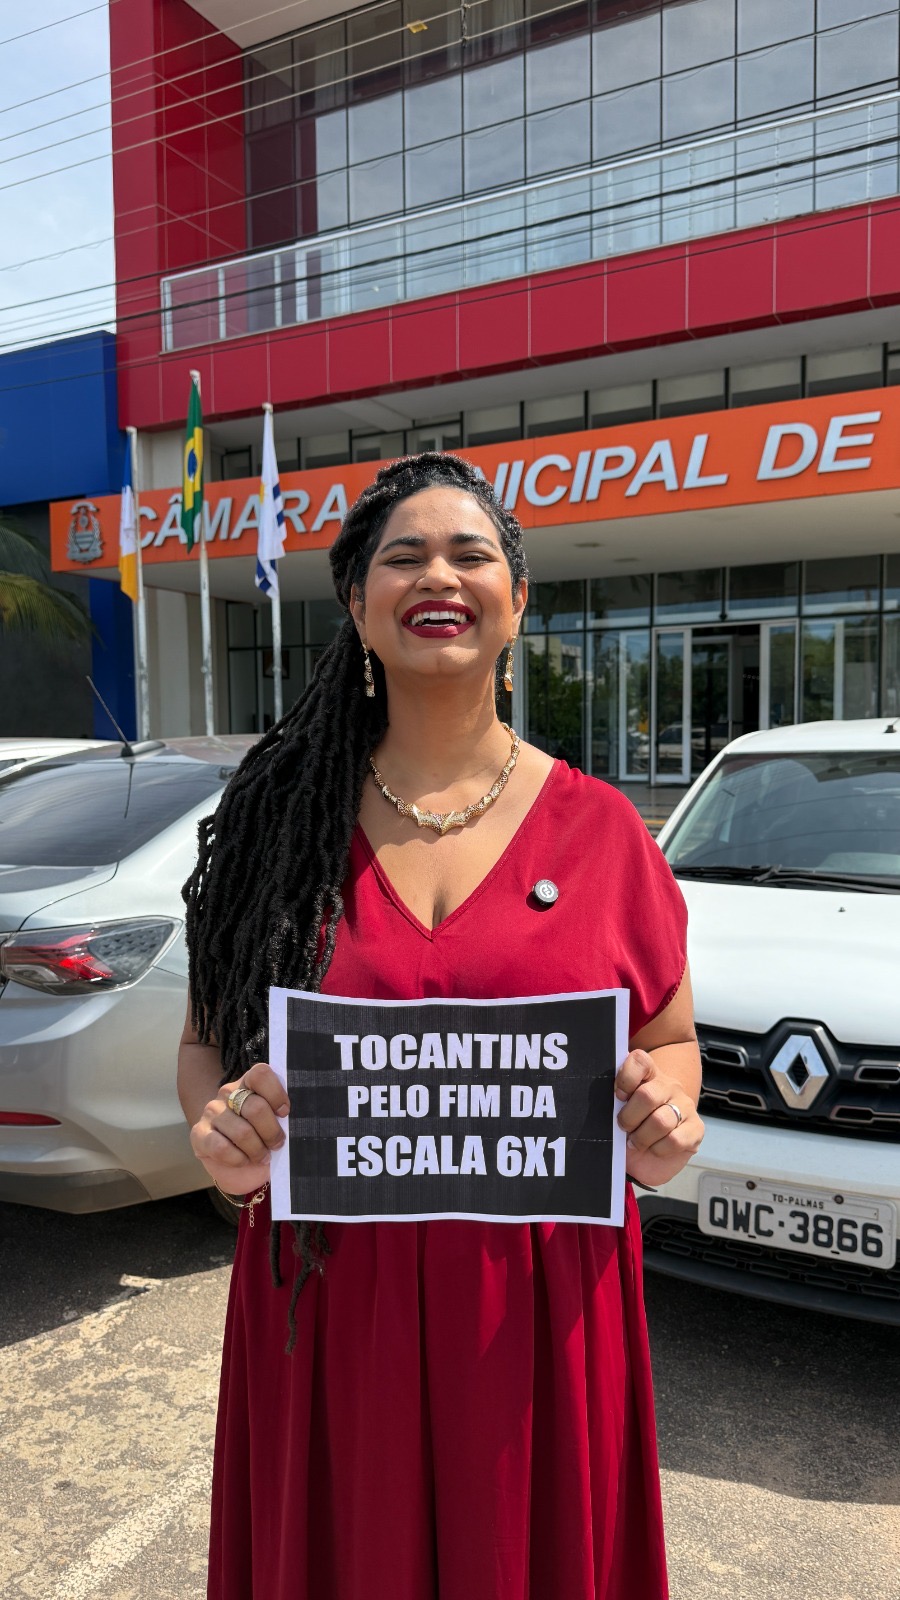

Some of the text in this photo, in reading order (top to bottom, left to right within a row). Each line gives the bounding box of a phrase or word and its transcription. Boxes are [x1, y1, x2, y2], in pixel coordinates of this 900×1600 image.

[137, 483, 349, 549] CÂMARA
[756, 411, 882, 481] DE
[333, 1032, 569, 1071] TOCANTINS
[348, 1084, 557, 1118] PELO FIM DA
[336, 1135, 567, 1178] ESCALA 6X1
[772, 1193, 825, 1210] TO-PALMAS
